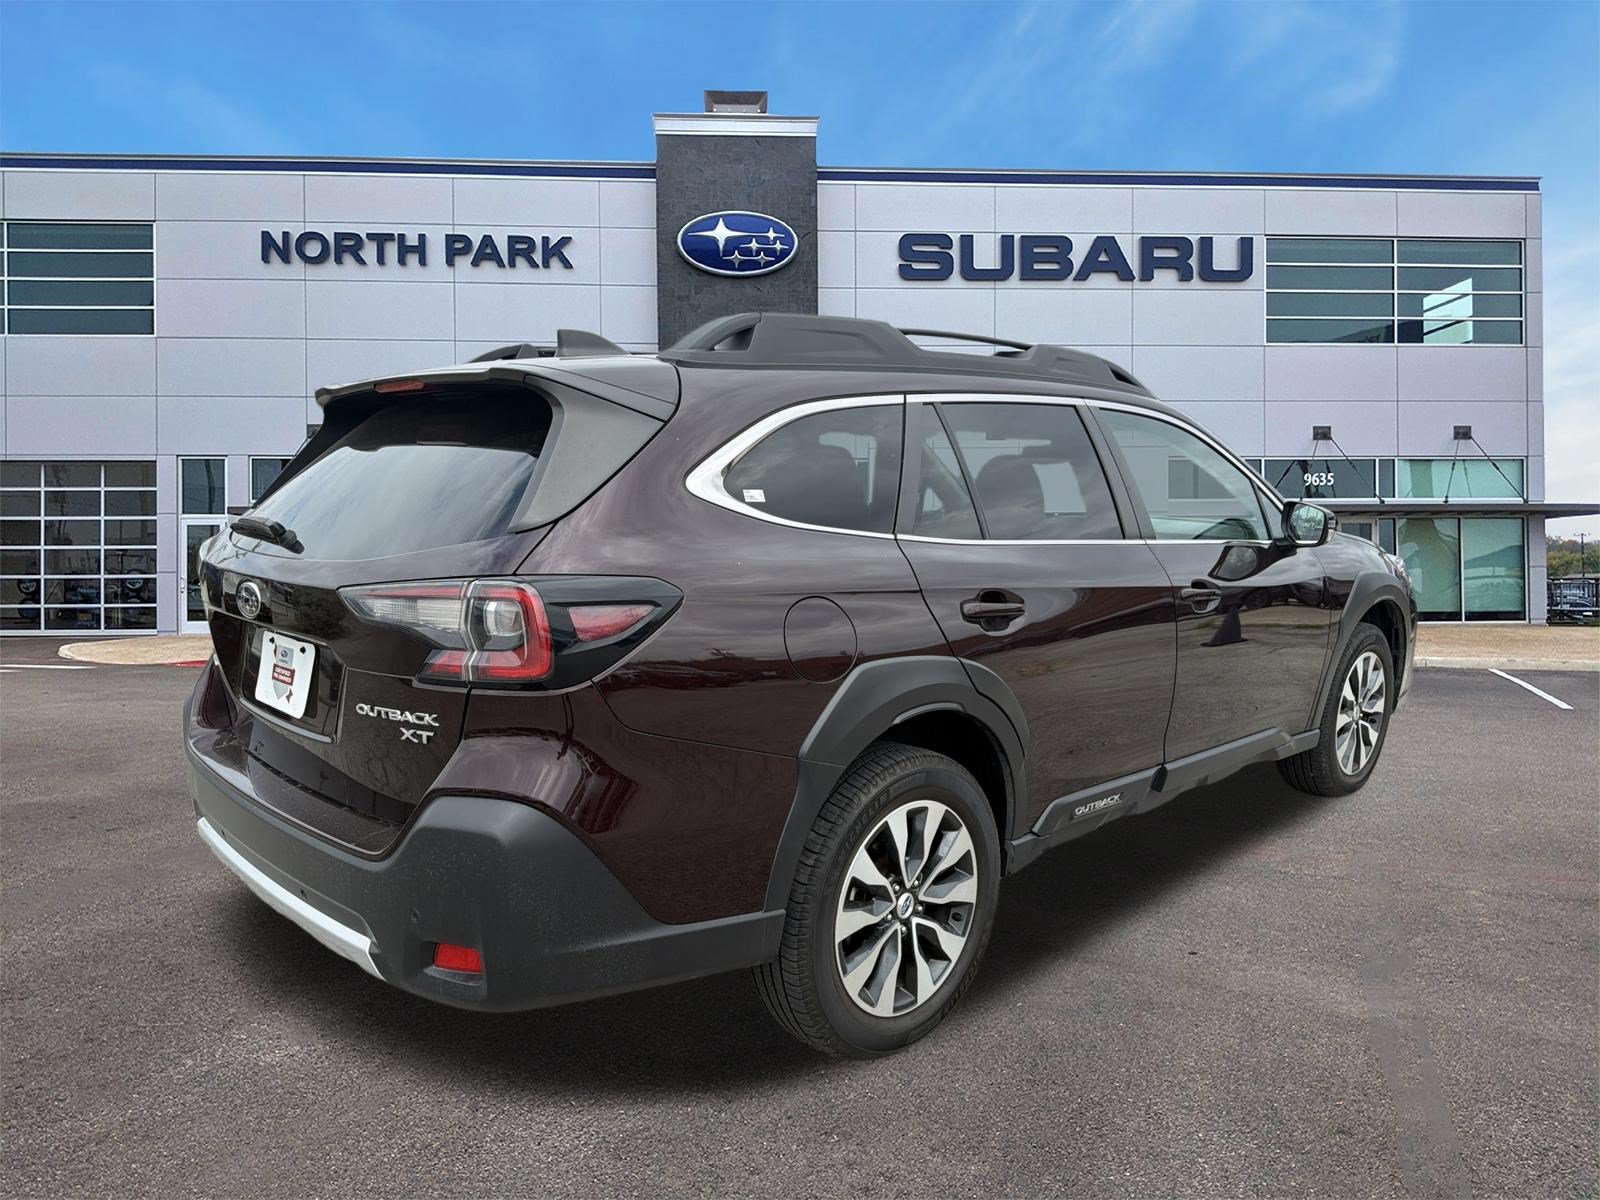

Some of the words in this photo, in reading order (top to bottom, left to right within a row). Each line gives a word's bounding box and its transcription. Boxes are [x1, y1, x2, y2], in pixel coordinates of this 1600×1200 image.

[260, 230, 428, 266] NORTH
[444, 233, 575, 269] PARK
[898, 233, 1254, 282] SUBARU
[1304, 472, 1334, 486] 9635
[355, 703, 440, 727] OUTBACK
[399, 726, 435, 745] XT
[1074, 793, 1121, 815] OUTBACK
